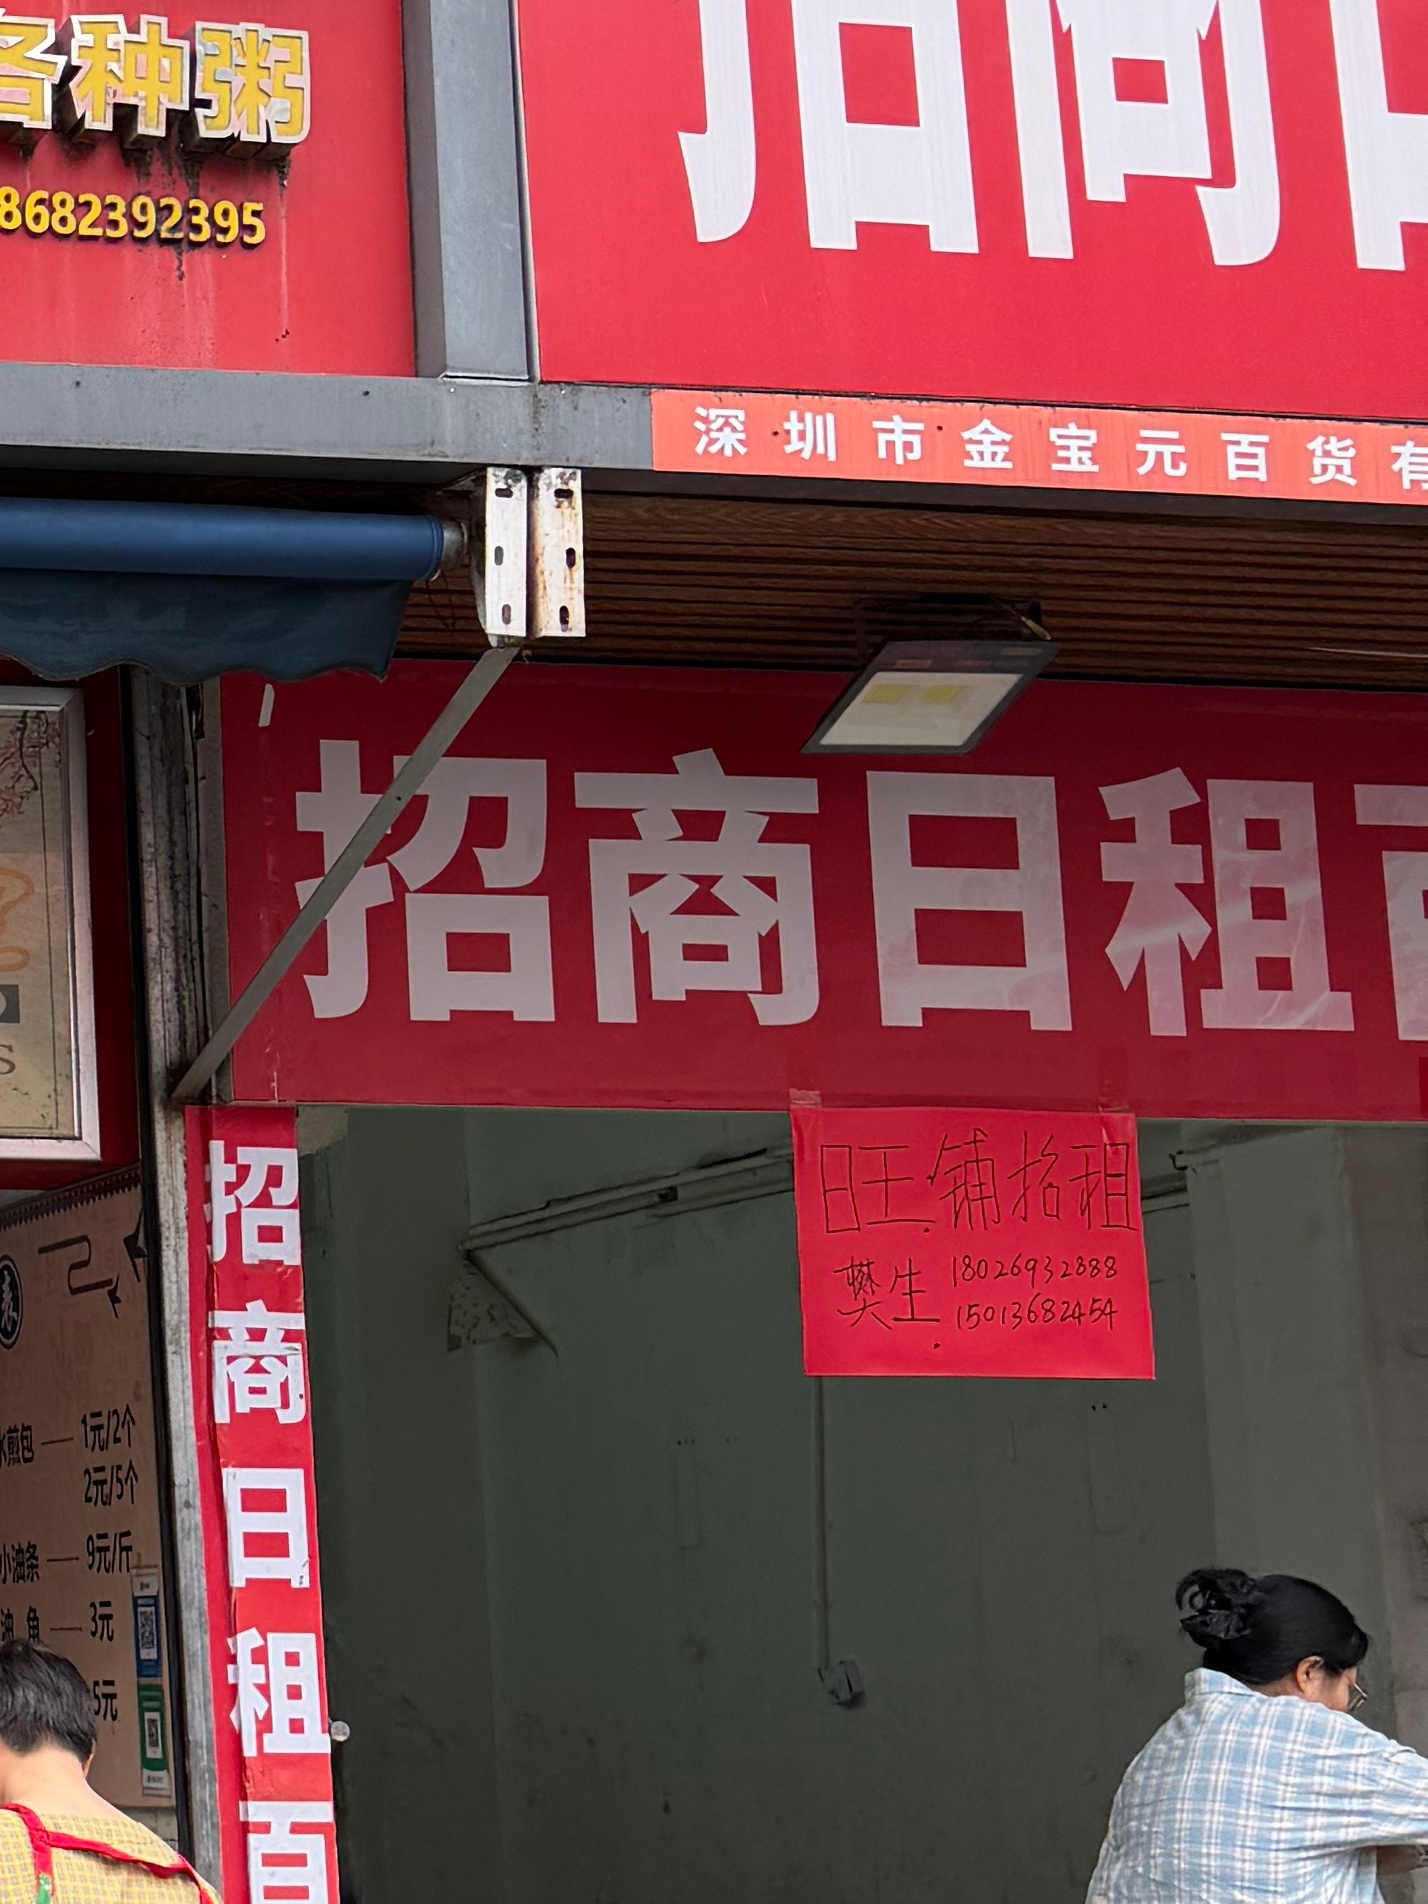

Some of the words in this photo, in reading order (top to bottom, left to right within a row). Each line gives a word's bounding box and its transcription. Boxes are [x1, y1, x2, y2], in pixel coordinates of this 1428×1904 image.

[693, 407, 1428, 490] 深圳市金宝元百货有
[819, 1127, 1138, 1234] 旺铺招租
[952, 1252, 1118, 1288] 18026932888
[956, 1292, 1118, 1331] 15013682454
[81, 1403, 136, 1452] 1元/2个
[84, 1458, 139, 1507] 2元/5个
[0, 1541, 40, 1585] 小油条
[86, 1530, 133, 1574] 9元/斤
[89, 1601, 114, 1642] 3元
